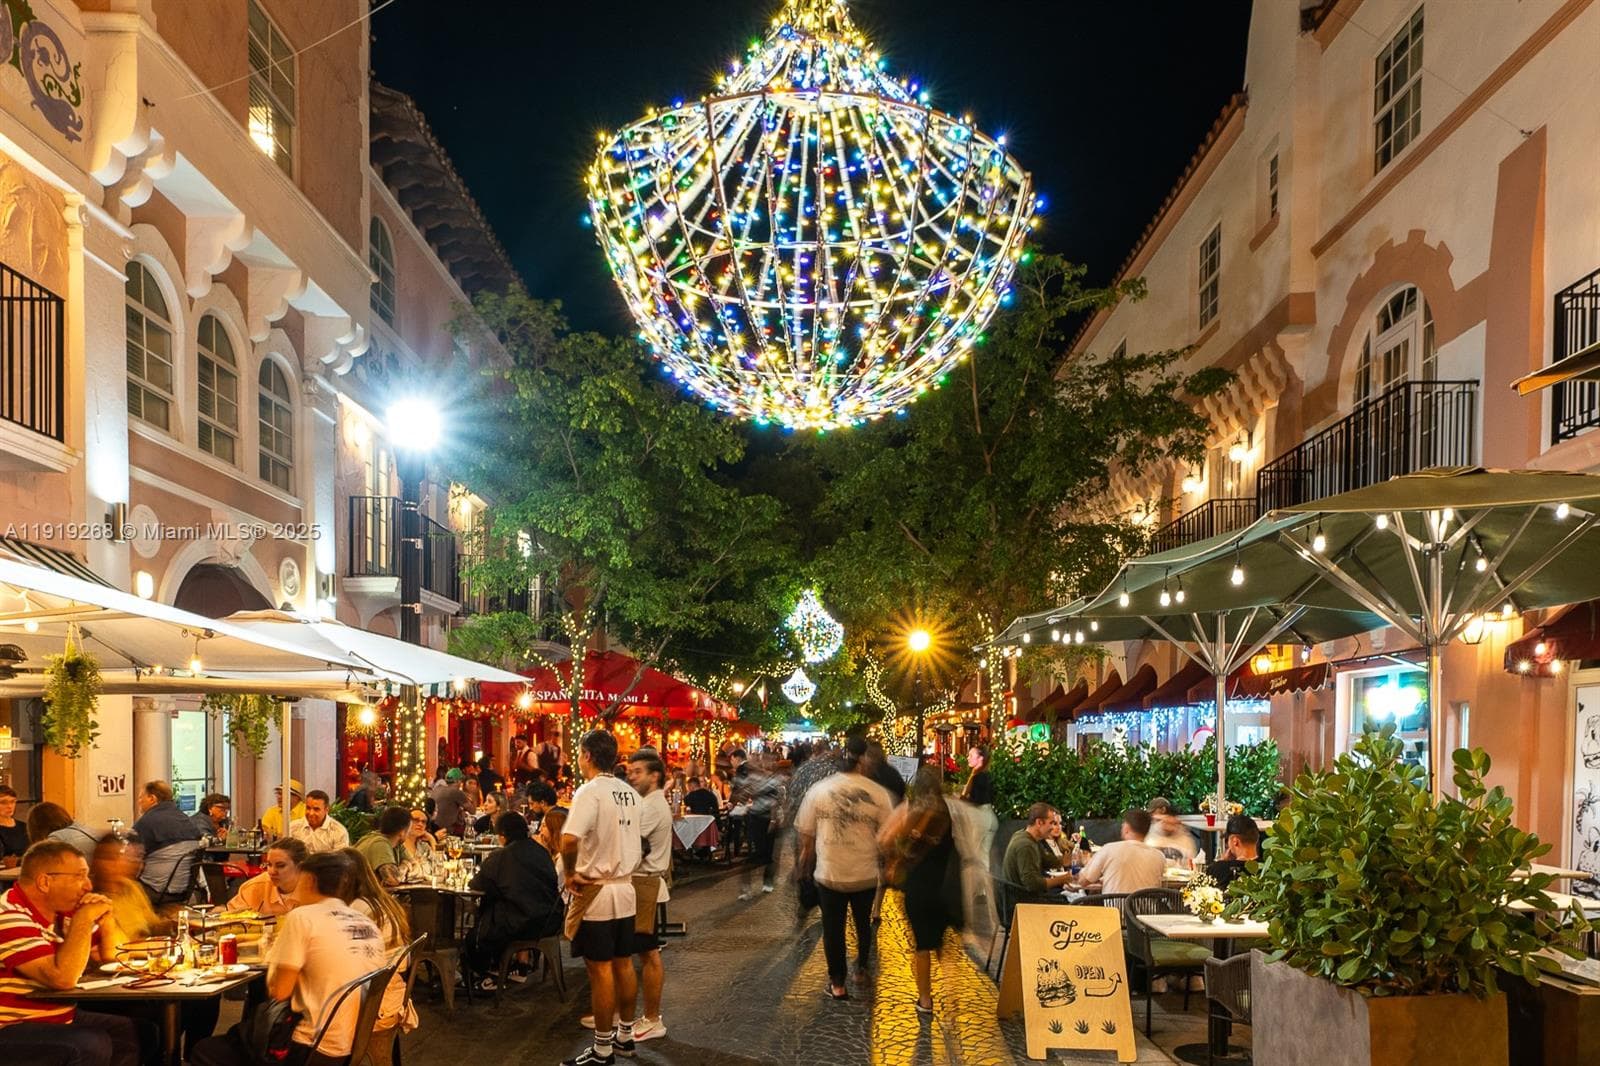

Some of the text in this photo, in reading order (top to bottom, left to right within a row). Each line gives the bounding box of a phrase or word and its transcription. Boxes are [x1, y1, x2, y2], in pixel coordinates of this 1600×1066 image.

[529, 688, 639, 703] ESPAÑITA MAMI
[1074, 964, 1105, 980] OPEN
